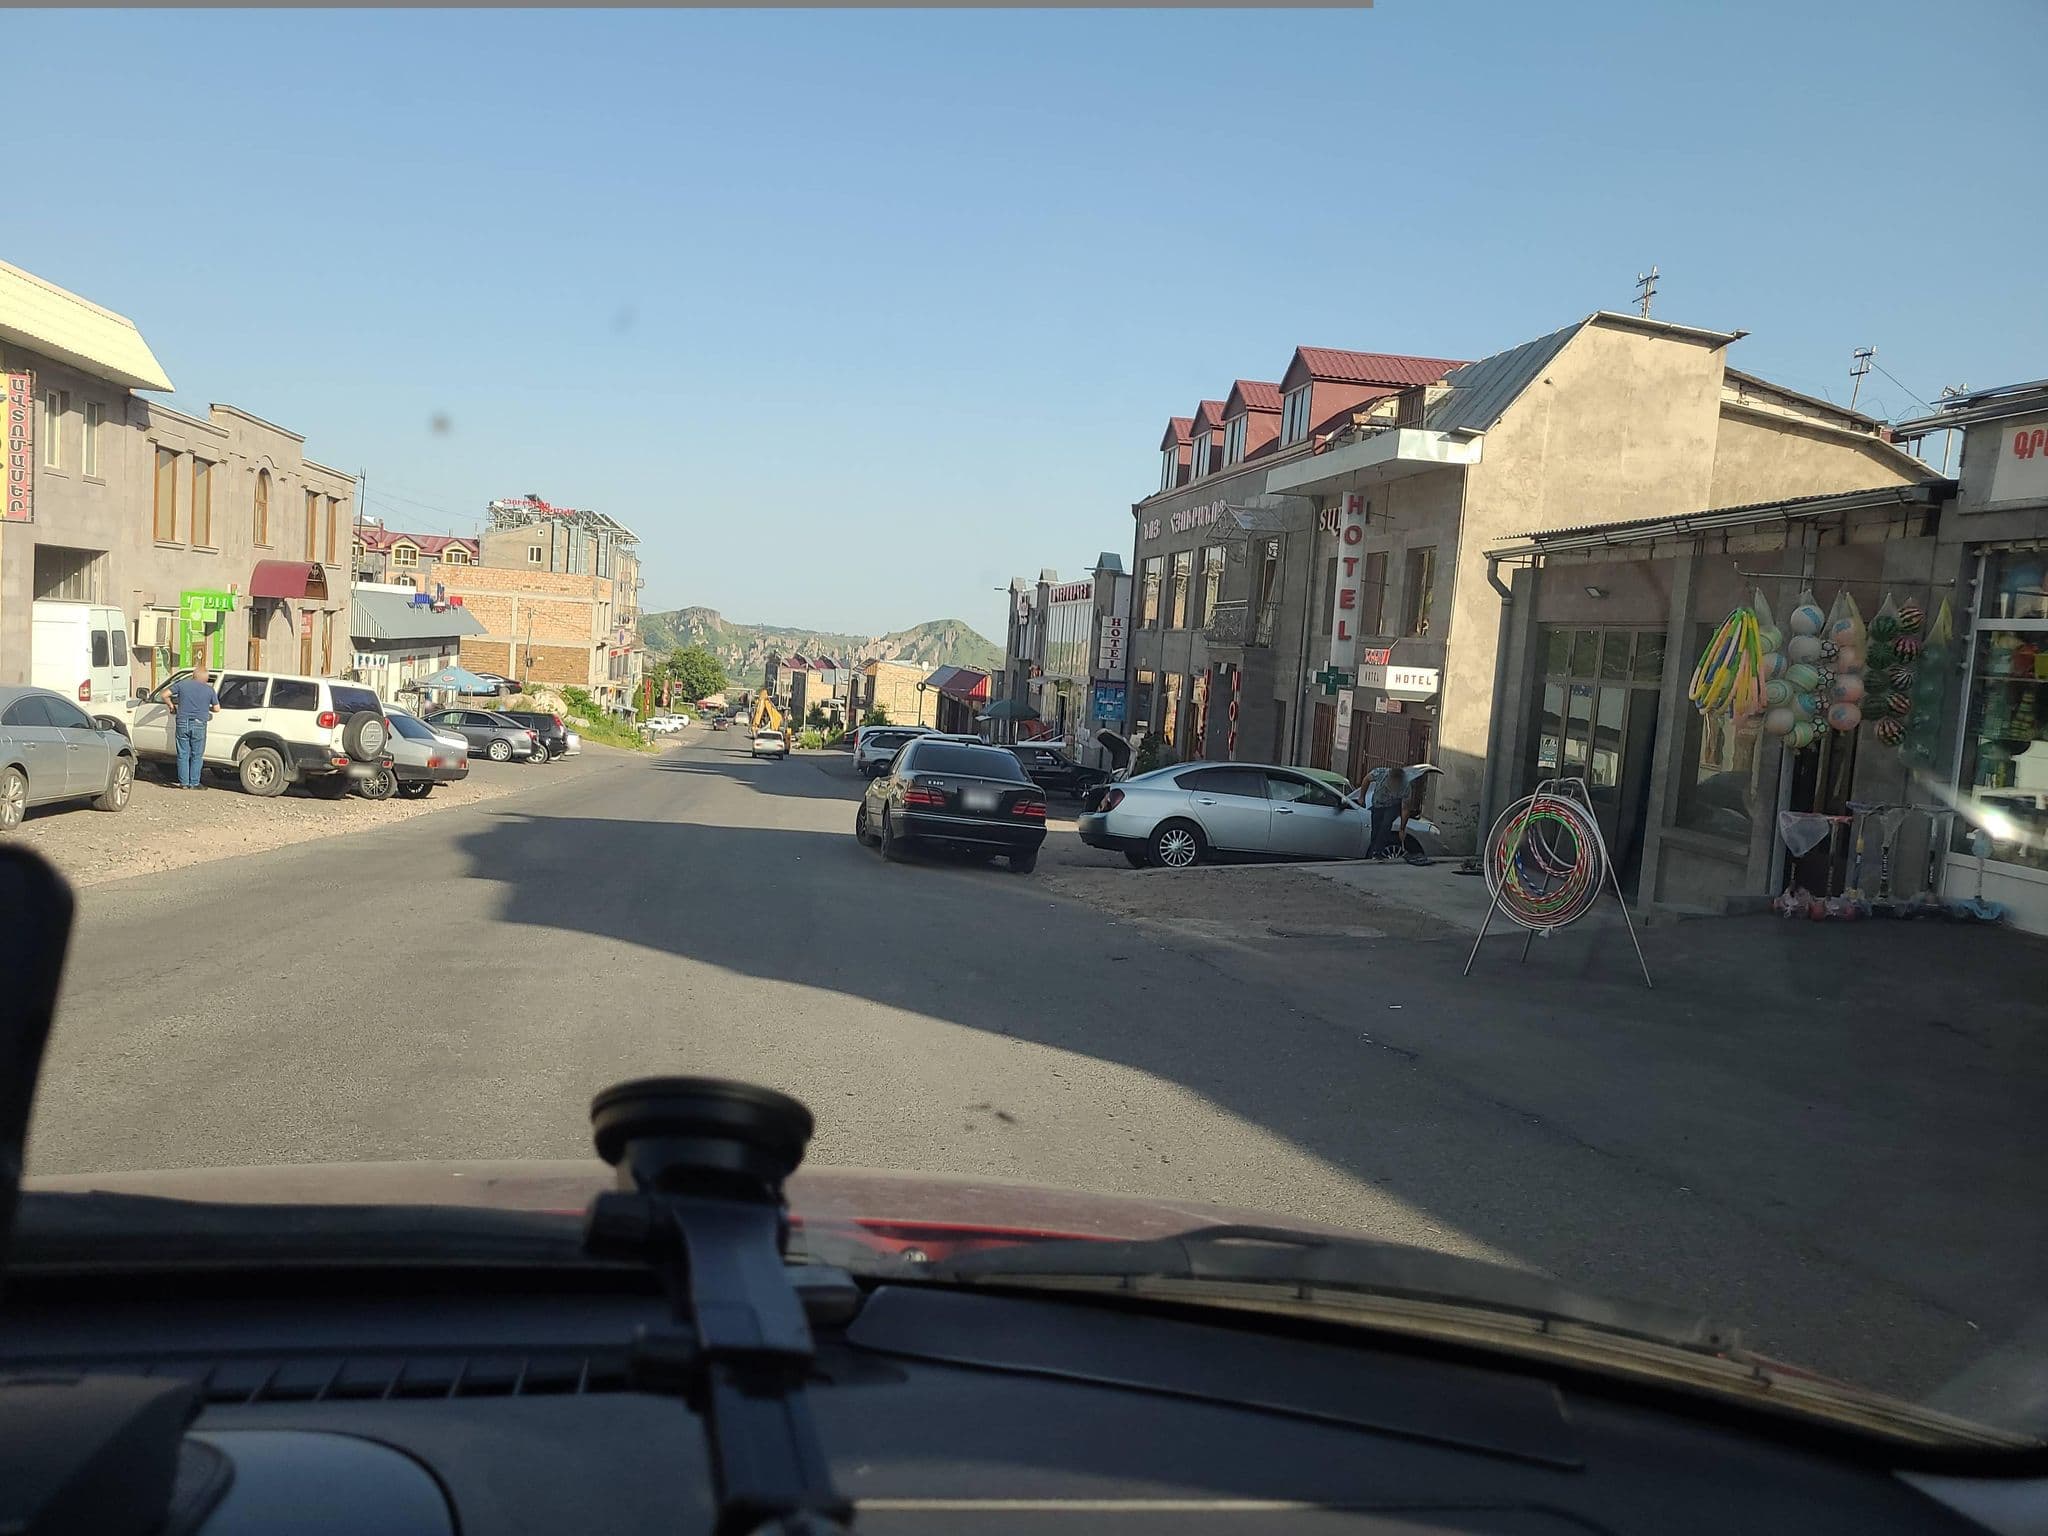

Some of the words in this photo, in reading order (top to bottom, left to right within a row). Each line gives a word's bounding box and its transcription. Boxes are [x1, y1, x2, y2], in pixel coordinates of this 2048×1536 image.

[2014, 428, 2048, 460] ԳՐ
[1337, 494, 1365, 641] HOTEL
[1109, 618, 1122, 669] HOTEL
[1395, 673, 1432, 686] HOTEL
